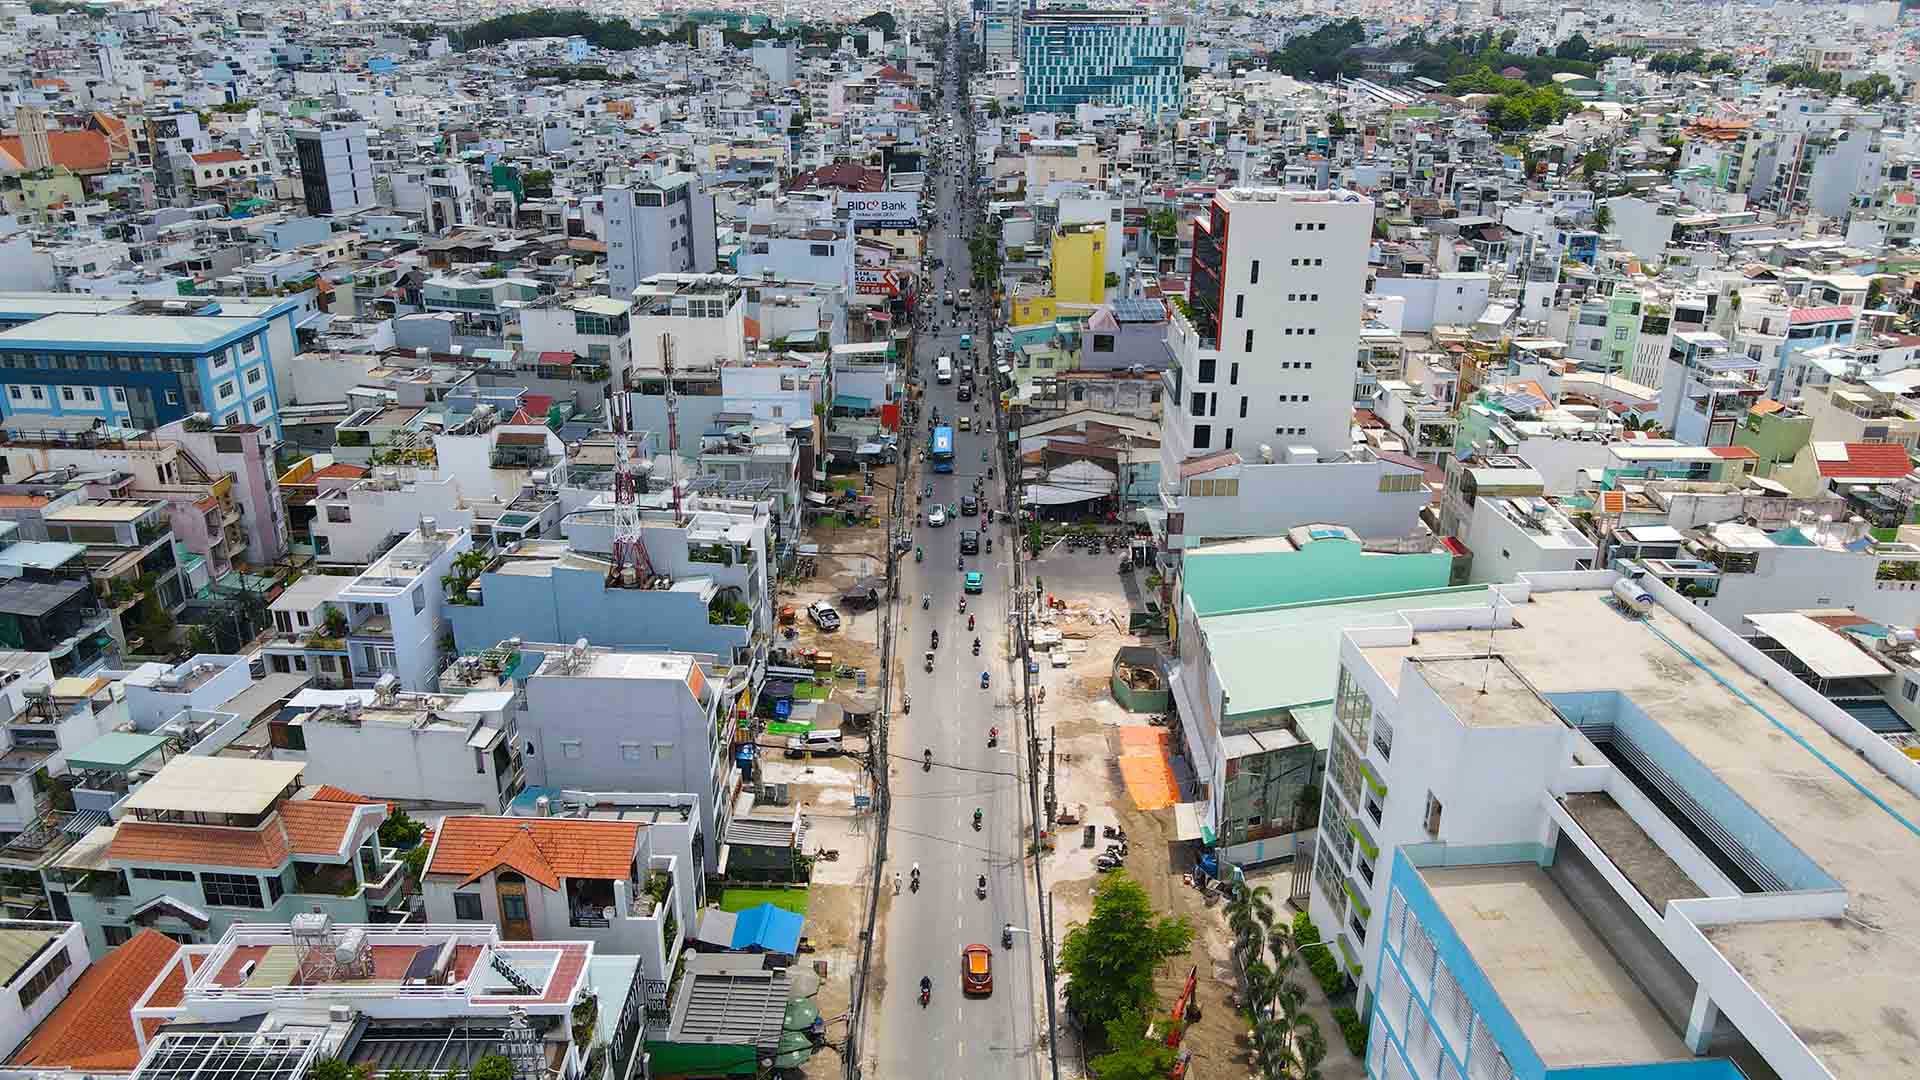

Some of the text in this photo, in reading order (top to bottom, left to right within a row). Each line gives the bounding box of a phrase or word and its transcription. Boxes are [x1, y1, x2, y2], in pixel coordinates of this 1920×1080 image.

[881, 201, 906, 210] Bank
[647, 983, 667, 993] GYM
[647, 1000, 667, 1009] YOGA
